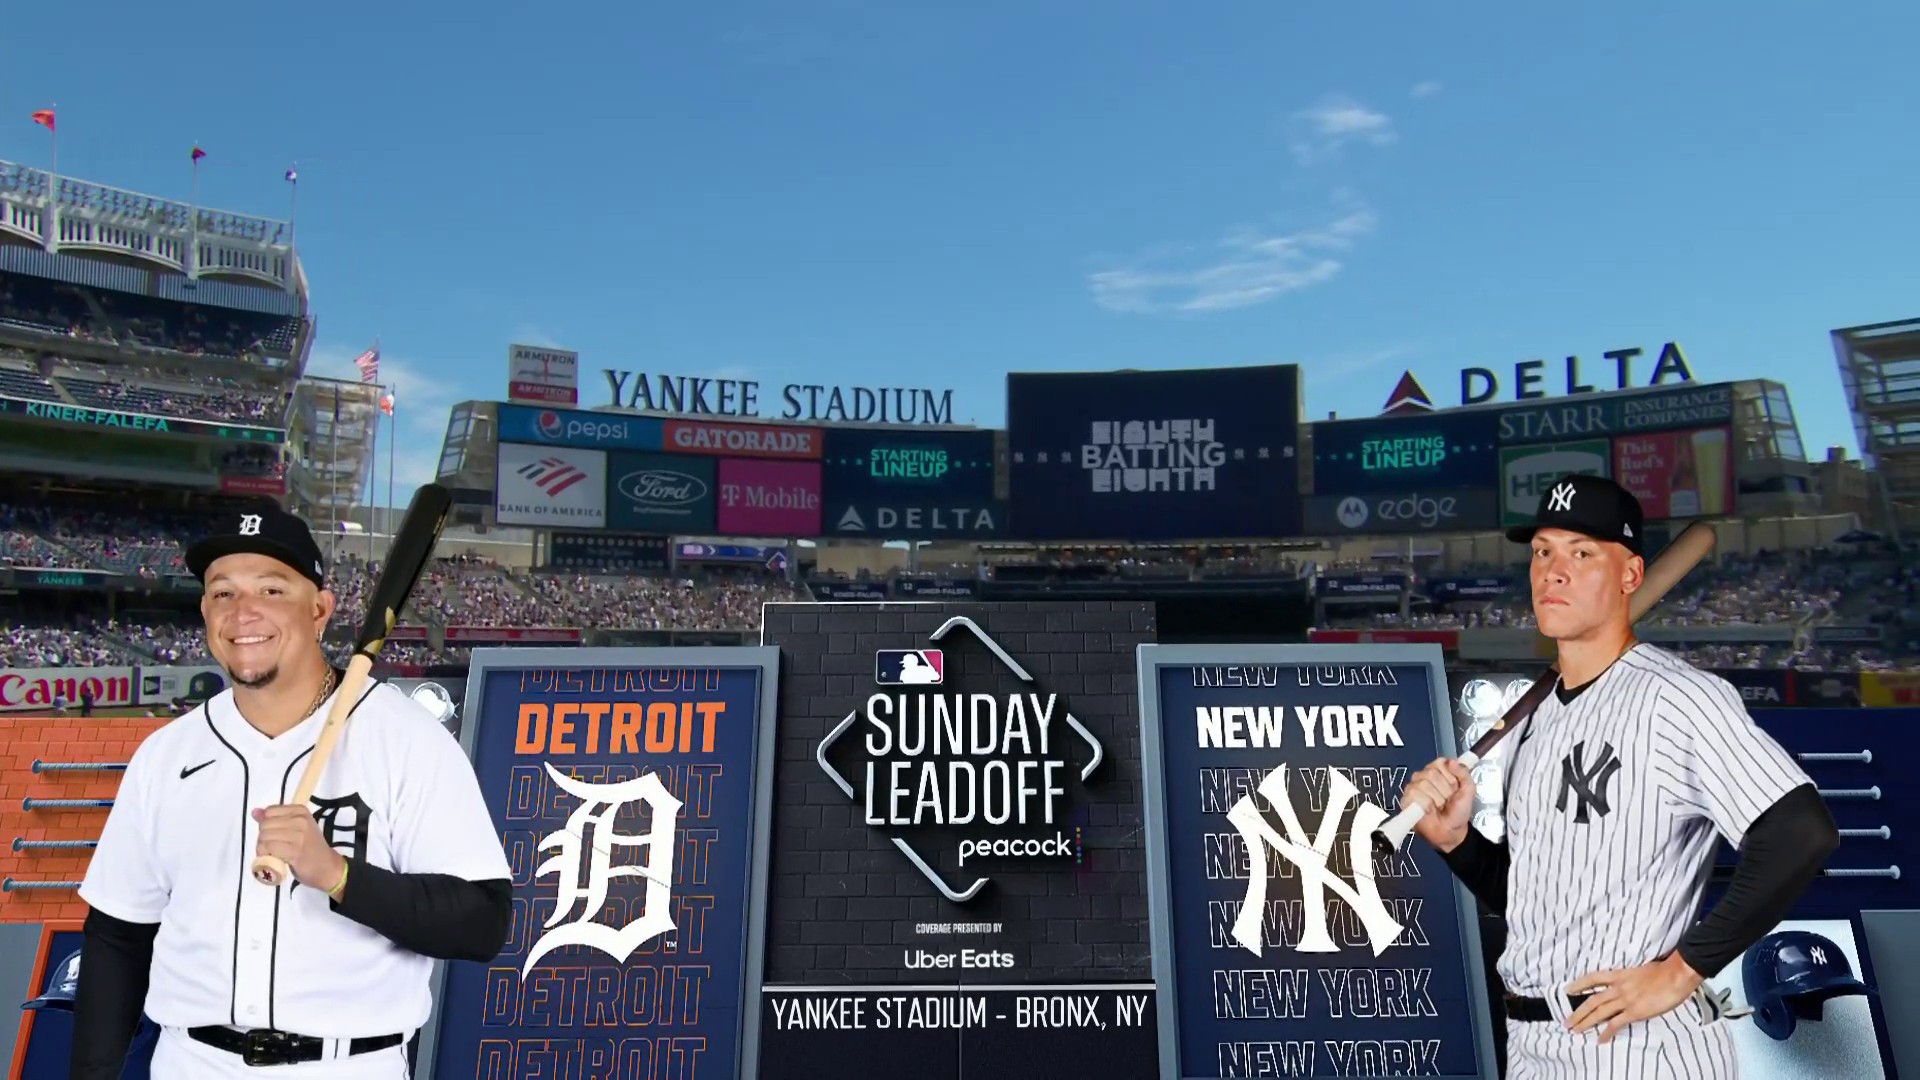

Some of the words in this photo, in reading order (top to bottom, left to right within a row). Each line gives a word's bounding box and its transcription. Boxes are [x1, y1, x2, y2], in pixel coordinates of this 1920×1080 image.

[515, 350, 576, 365] ARMITRON
[1460, 341, 1699, 404] DELTA
[602, 369, 759, 416] YANKEE
[782, 383, 953, 424] STADIUM
[1624, 390, 1731, 414] INSURANCE
[26, 401, 169, 433] KINER-FALEFA
[1499, 405, 1610, 439] STARR
[1624, 404, 1731, 428] COMPANIES
[567, 420, 628, 440] pepsi
[674, 427, 811, 452] GATORADE
[870, 449, 948, 463] STARTING
[1081, 442, 1226, 468] BATTING
[1362, 436, 1445, 454] STARTING
[1620, 441, 1656, 454] This
[870, 461, 948, 478] LINEUP
[1362, 450, 1446, 470] LINEUP
[1621, 455, 1664, 470] Bud's
[634, 473, 691, 500] Ford
[746, 486, 819, 509] Mobile
[1547, 482, 1577, 511] NY
[500, 504, 530, 514] BANK
[534, 505, 548, 515] OF
[551, 506, 602, 517] AMERICA
[877, 507, 995, 530] DELTA
[1378, 493, 1457, 527] edge
[239, 513, 263, 536] D
[38, 576, 84, 586] YANKEES
[0, 674, 129, 707] Canon
[514, 702, 726, 754] DETROIT
[866, 693, 1057, 756] SUNDAY
[1196, 706, 1284, 748] NEW
[1294, 704, 1404, 747] YORK
[865, 760, 1065, 825] LEADOFF
[1555, 740, 1622, 824] NY
[958, 831, 1072, 867] peacock
[916, 924, 951, 934] COVERAGE
[953, 923, 992, 934] PRESENTED
[993, 923, 1003, 933] BY
[904, 950, 956, 969] Uber
[961, 949, 1015, 968] Eats
[483, 965, 711, 1026] DETROIT
[1214, 970, 1308, 1018] NEW
[1318, 968, 1438, 1018] YORK
[772, 998, 867, 1030] YANKEE
[876, 997, 987, 1029] STADIUM
[1016, 996, 1107, 1031] BRONX,
[1117, 996, 1148, 1028] NY
[1218, 1041, 1315, 1079] NEW
[1324, 1040, 1441, 1078] YORK
